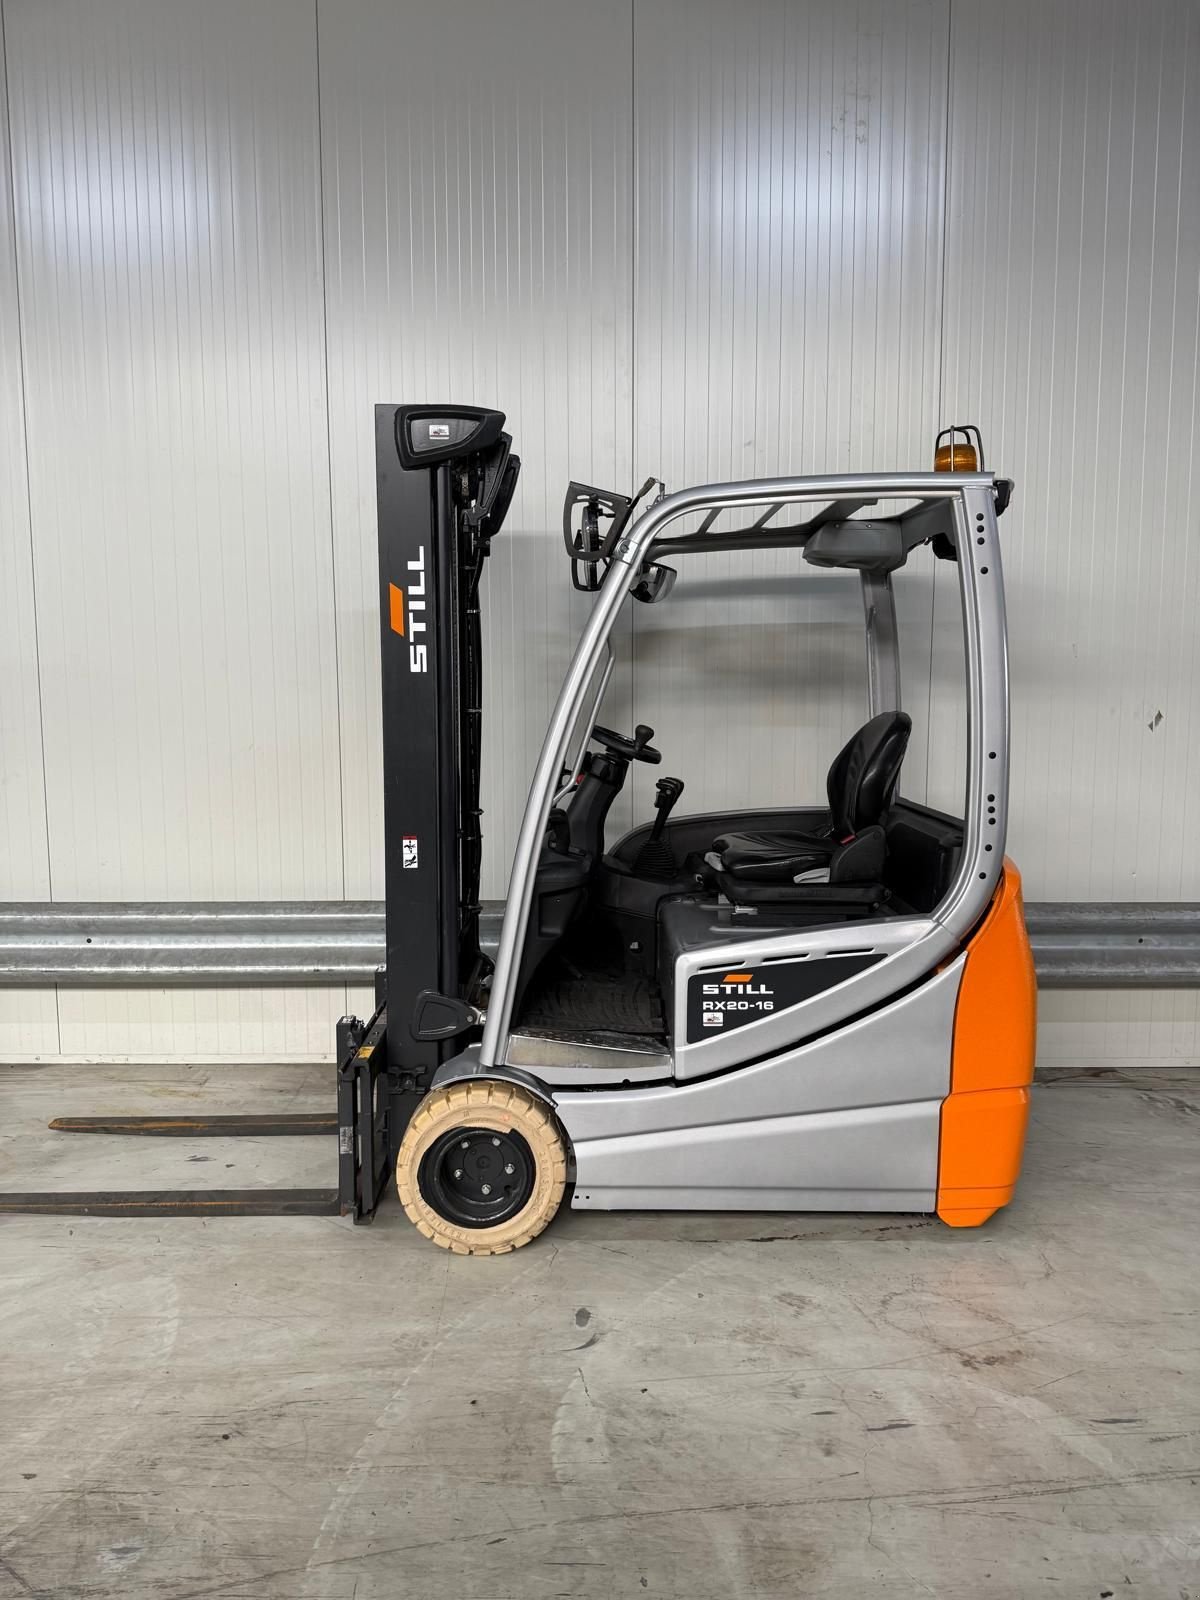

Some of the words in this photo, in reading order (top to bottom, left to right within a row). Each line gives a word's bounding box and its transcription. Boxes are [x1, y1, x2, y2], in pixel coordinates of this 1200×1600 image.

[407, 546, 427, 672] STILL
[703, 984, 774, 994] STILL
[703, 1001, 774, 1010] RX20-16
